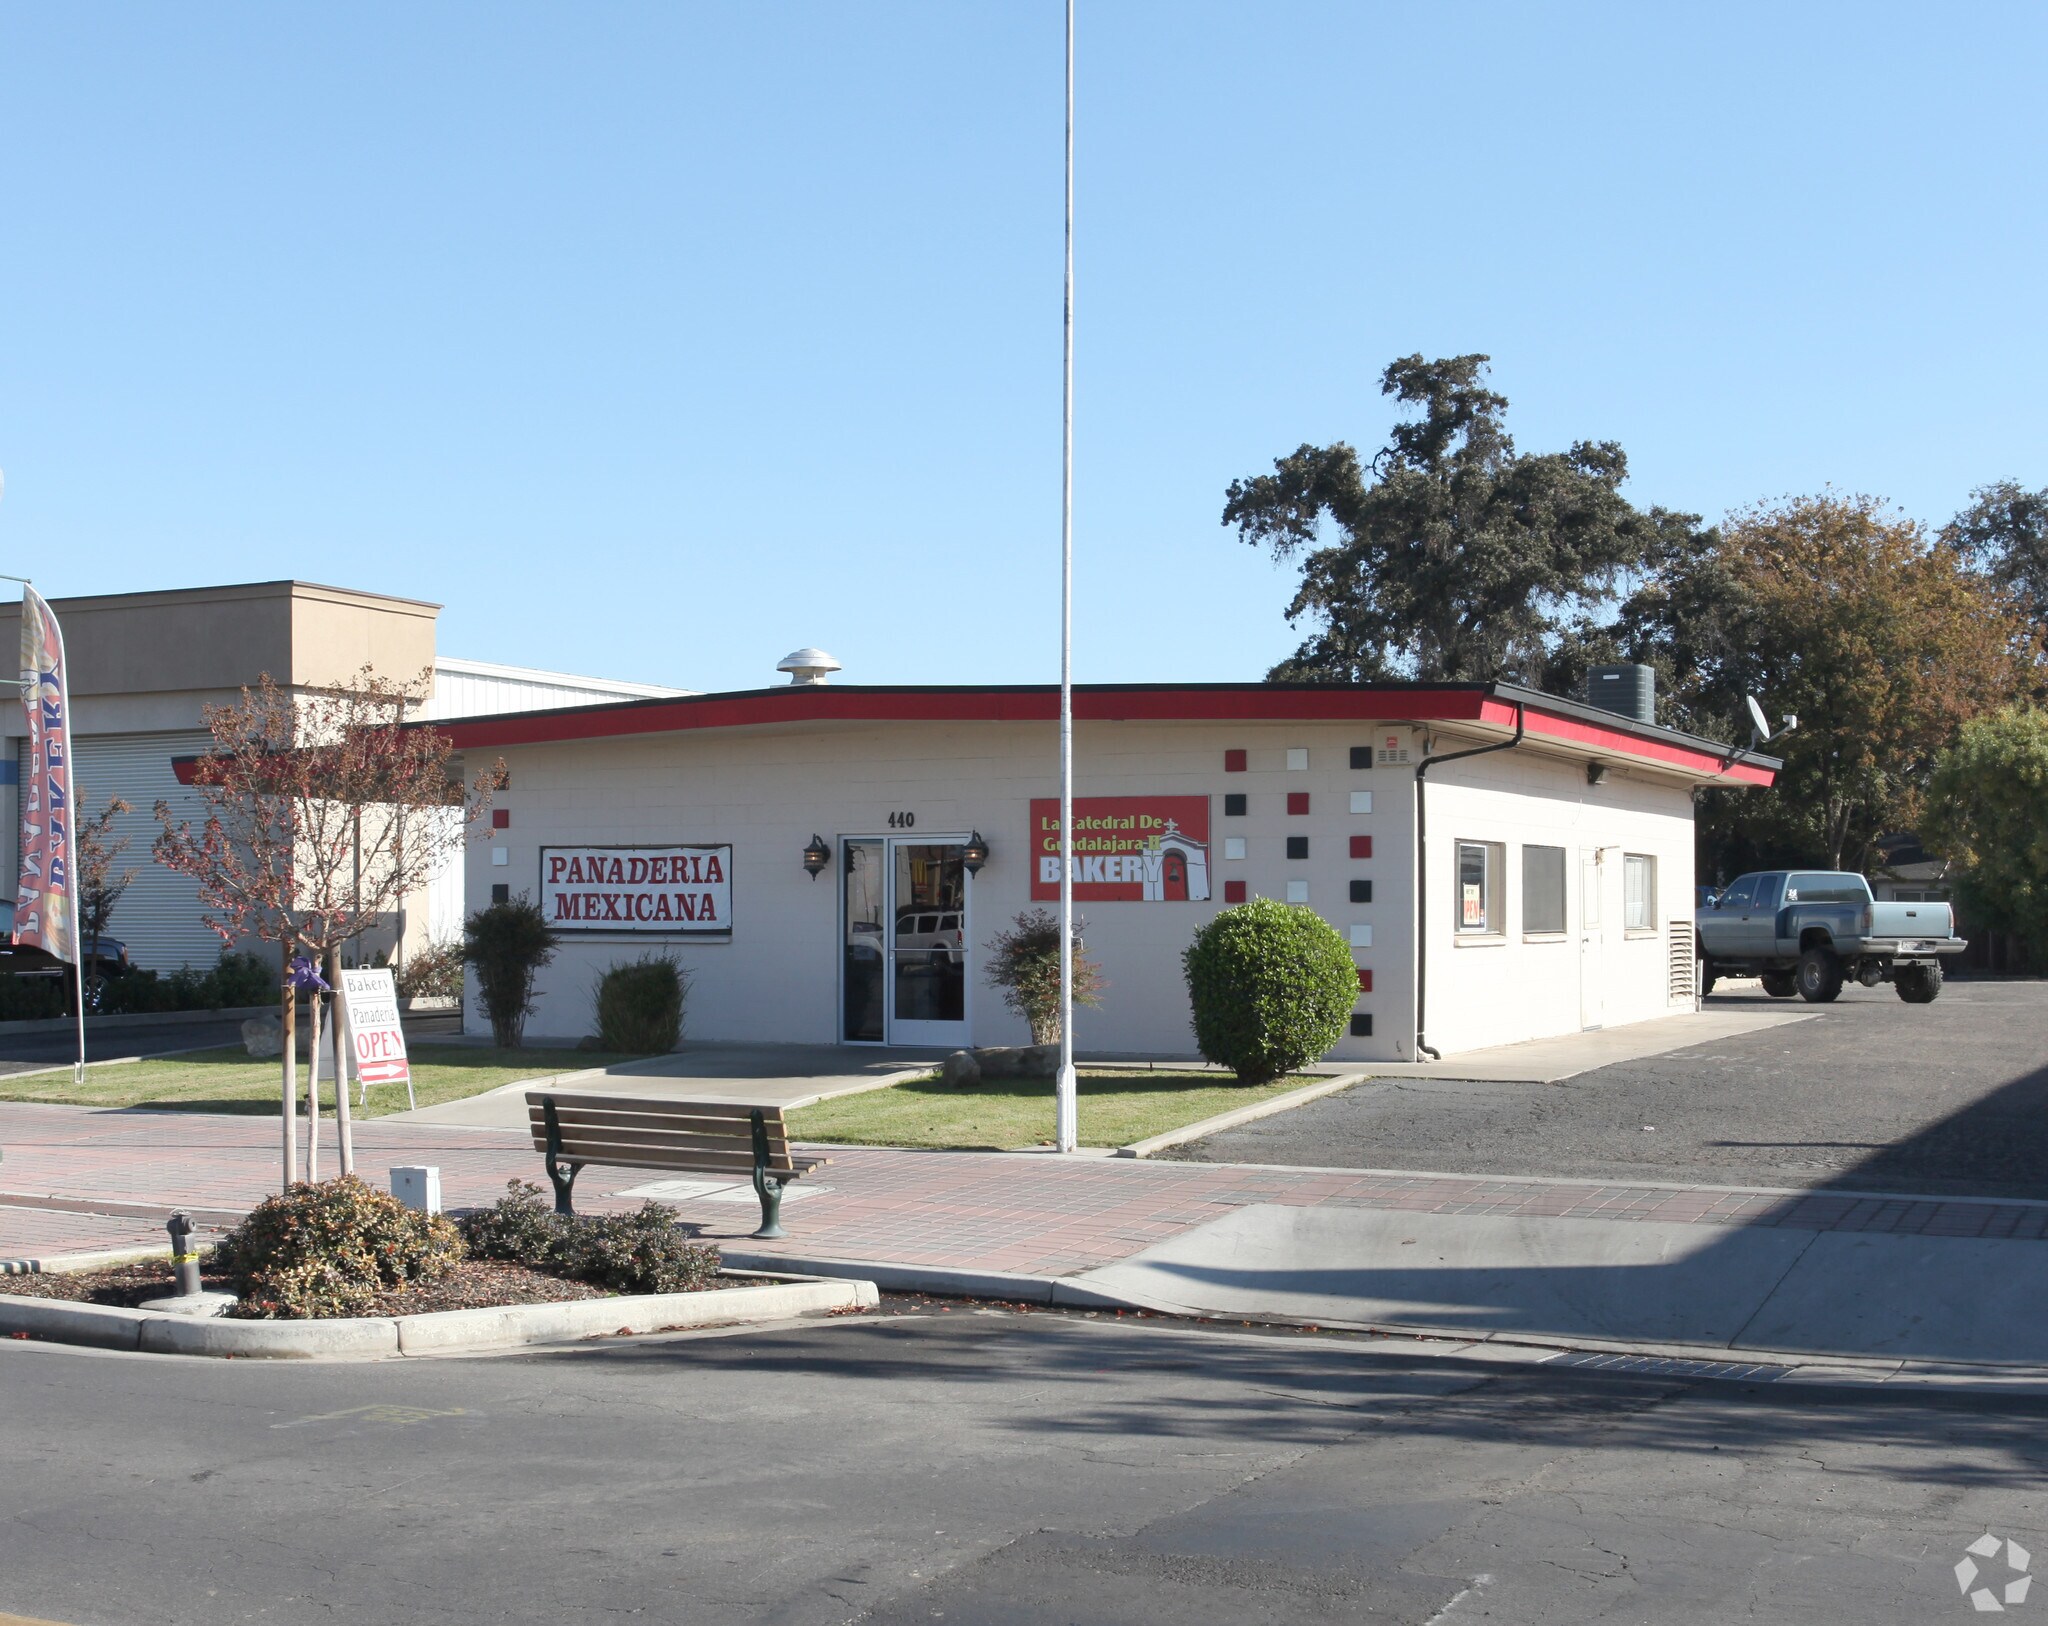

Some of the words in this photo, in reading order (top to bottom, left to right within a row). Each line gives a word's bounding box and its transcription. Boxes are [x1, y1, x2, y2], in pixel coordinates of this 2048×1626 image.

[888, 811, 915, 828] 440
[1041, 816, 1061, 831] La
[1139, 814, 1163, 829] De
[548, 855, 724, 884] PANADERIA
[1039, 855, 1165, 883] BAKERY
[554, 893, 717, 921] MEXICANA
[1465, 900, 1478, 919] PEN
[347, 977, 388, 994] Bakery
[357, 1031, 403, 1059] OPEN
